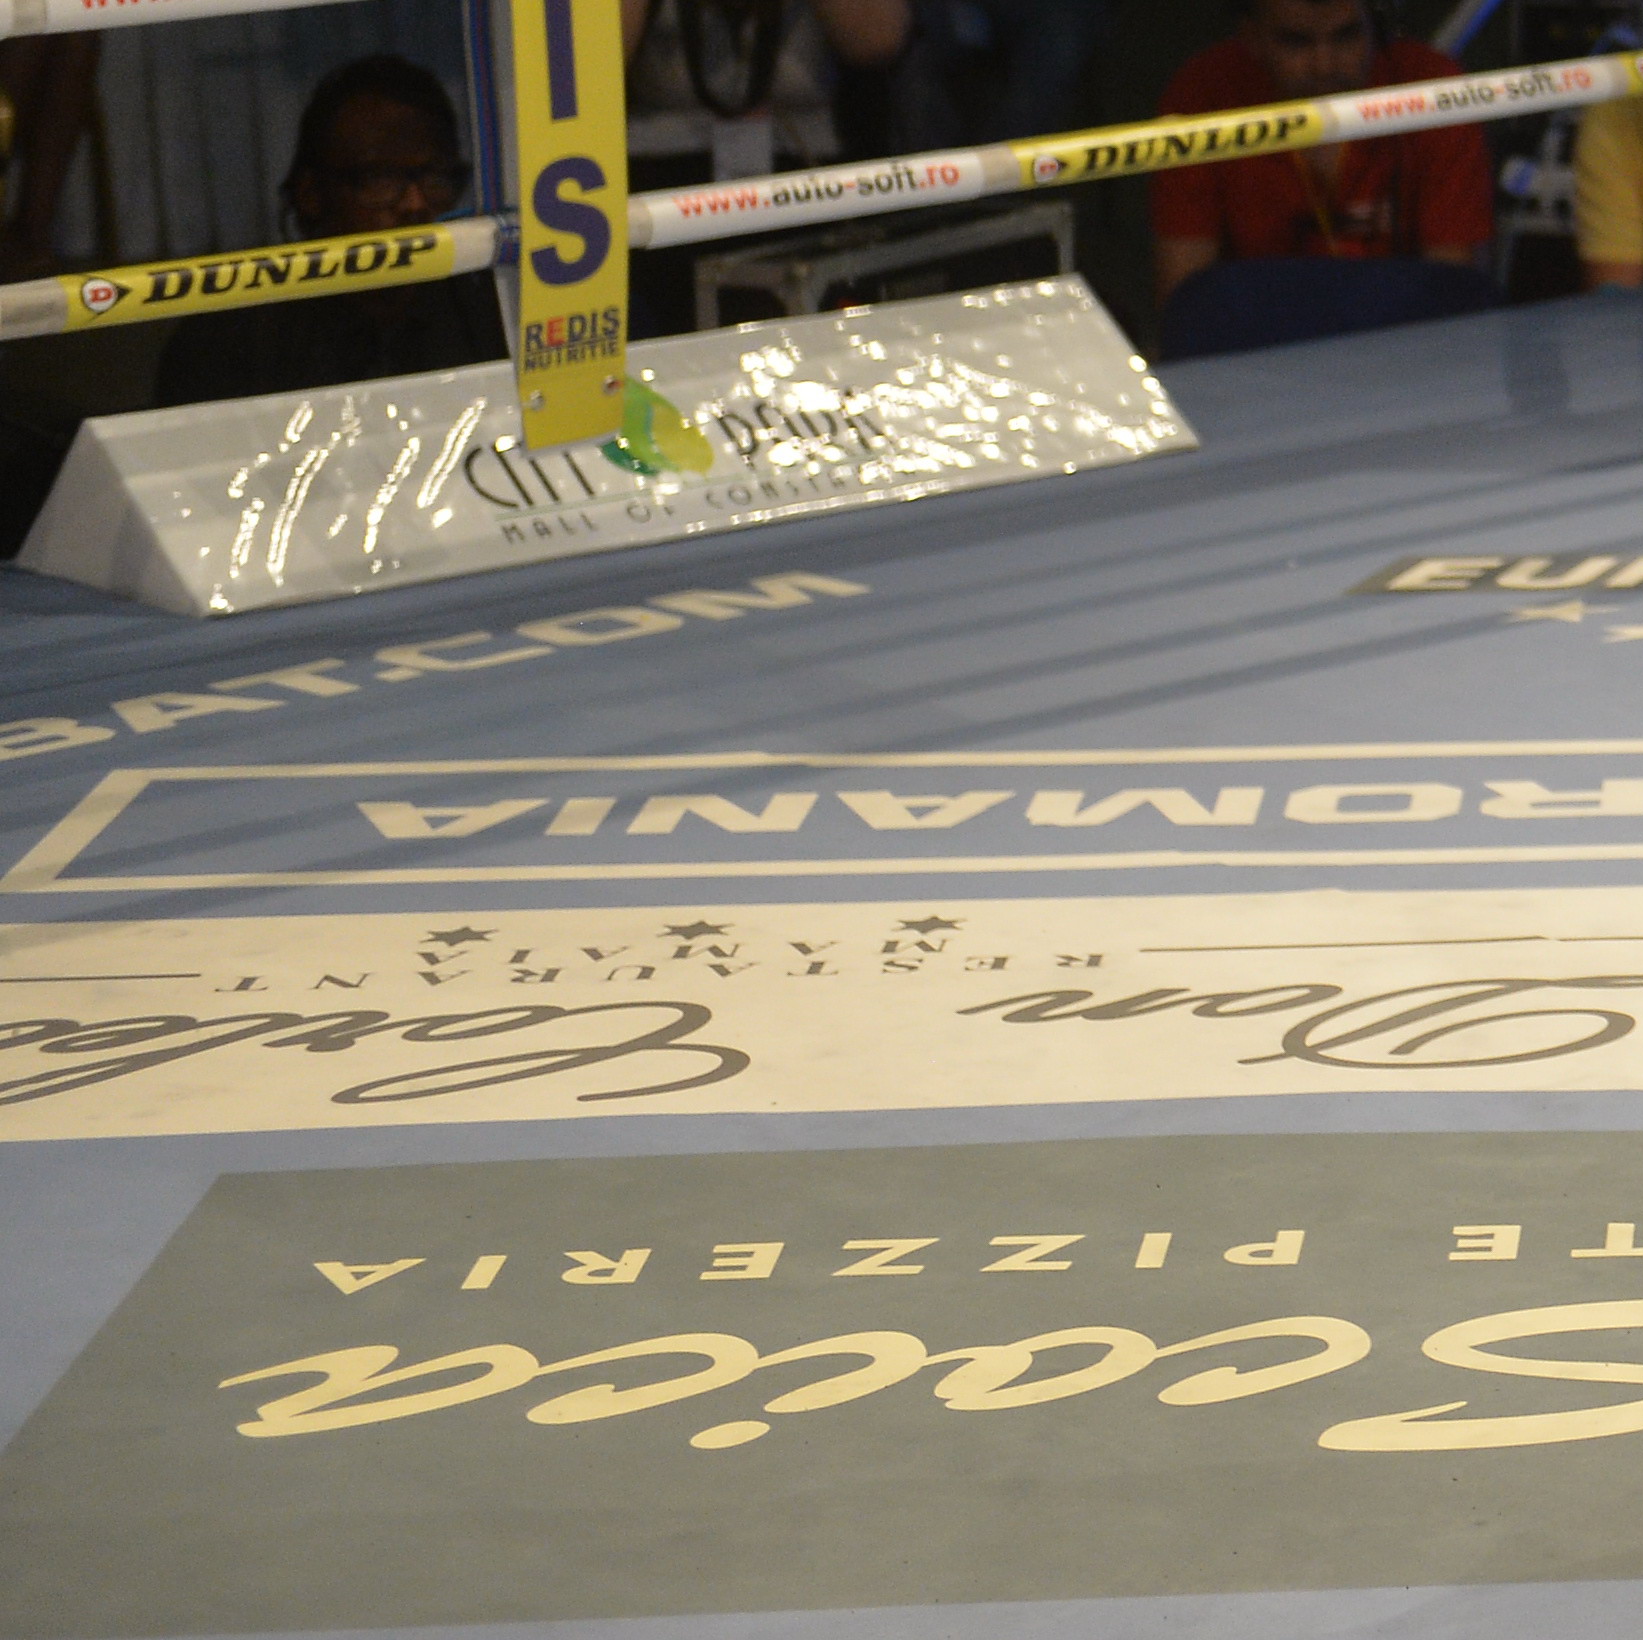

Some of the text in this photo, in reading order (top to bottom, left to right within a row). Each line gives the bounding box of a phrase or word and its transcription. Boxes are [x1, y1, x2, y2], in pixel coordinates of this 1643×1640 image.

[1356, 66, 1593, 122] www.auto-soft.ro
[1082, 113, 1308, 176] DUNLOP
[673, 161, 960, 217] www.auto-soft.ro
[142, 235, 437, 305] DUNLOP
[525, 308, 619, 354] REDIS
[215, 953, 1104, 993] RESTAURANT
[418, 936, 954, 967] MAMAIA
[312, 1227, 1309, 1297] PIZZERIA
